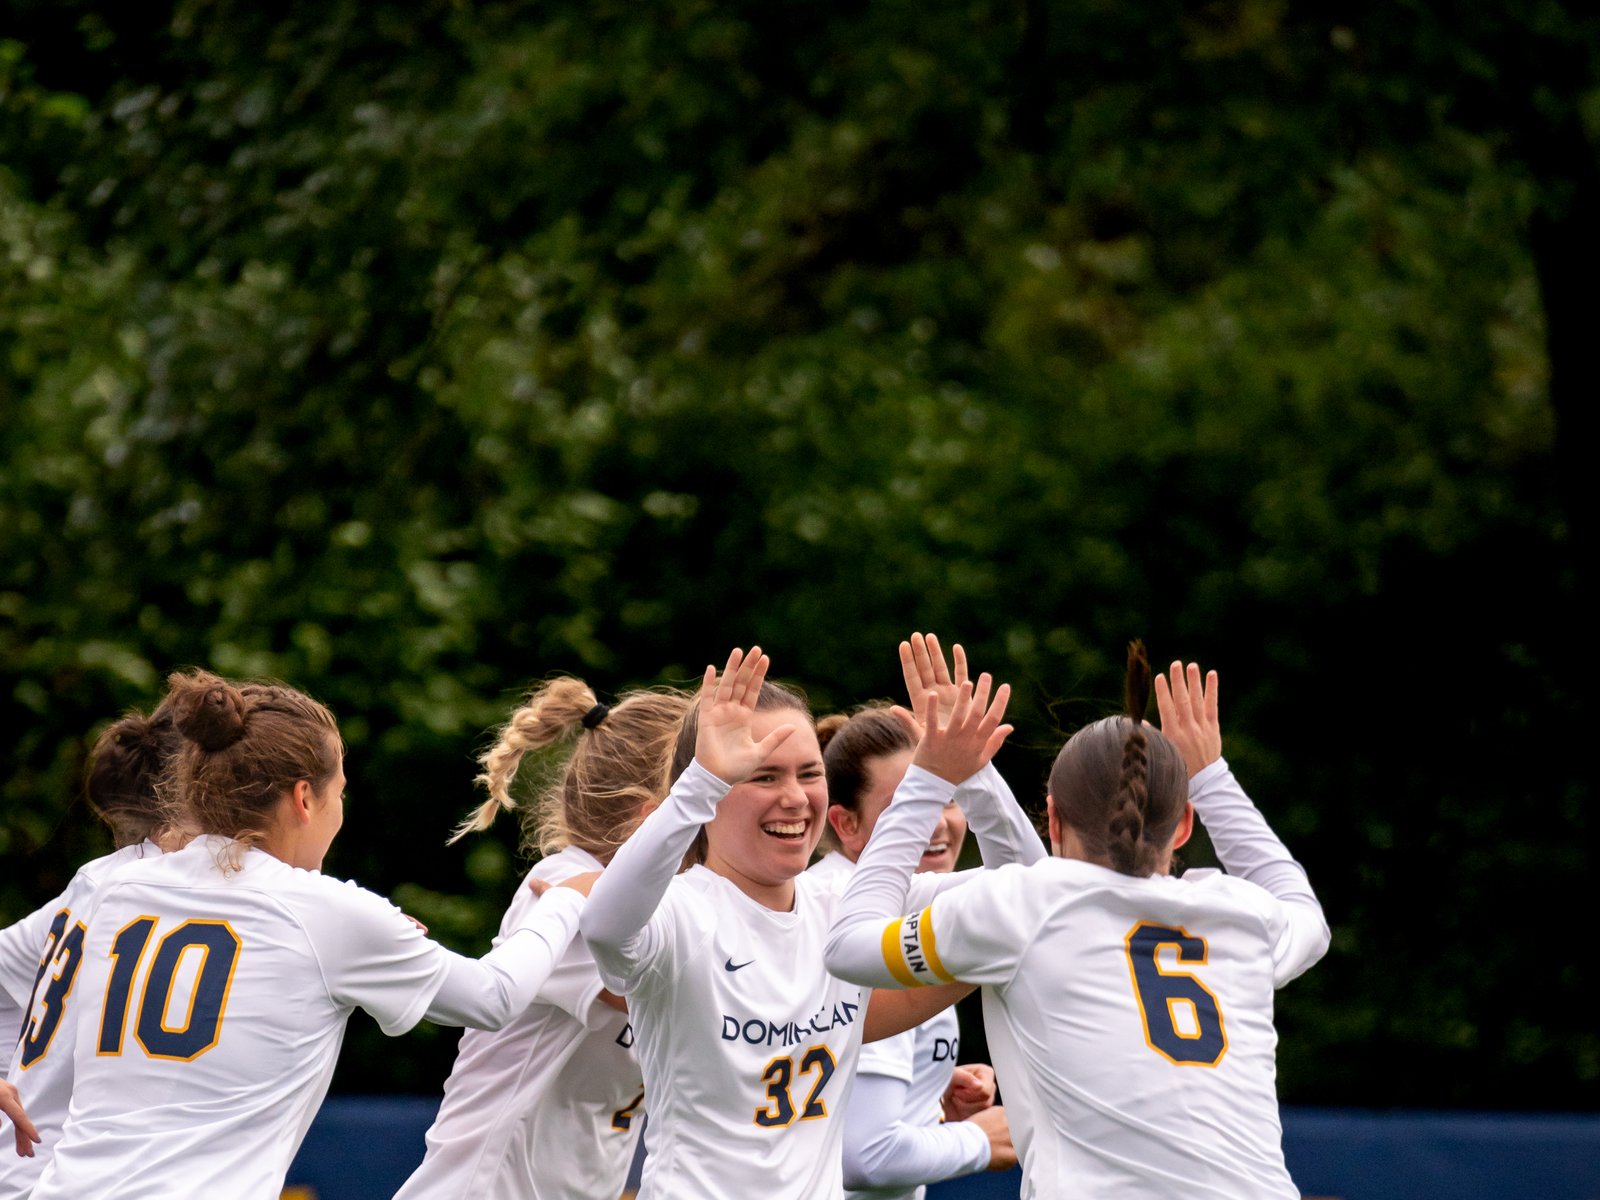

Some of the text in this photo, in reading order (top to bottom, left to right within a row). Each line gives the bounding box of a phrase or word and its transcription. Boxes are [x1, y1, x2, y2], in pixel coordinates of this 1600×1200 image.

[97, 914, 243, 1063] 10
[1124, 919, 1229, 1067] 6
[754, 1043, 838, 1129] 32
